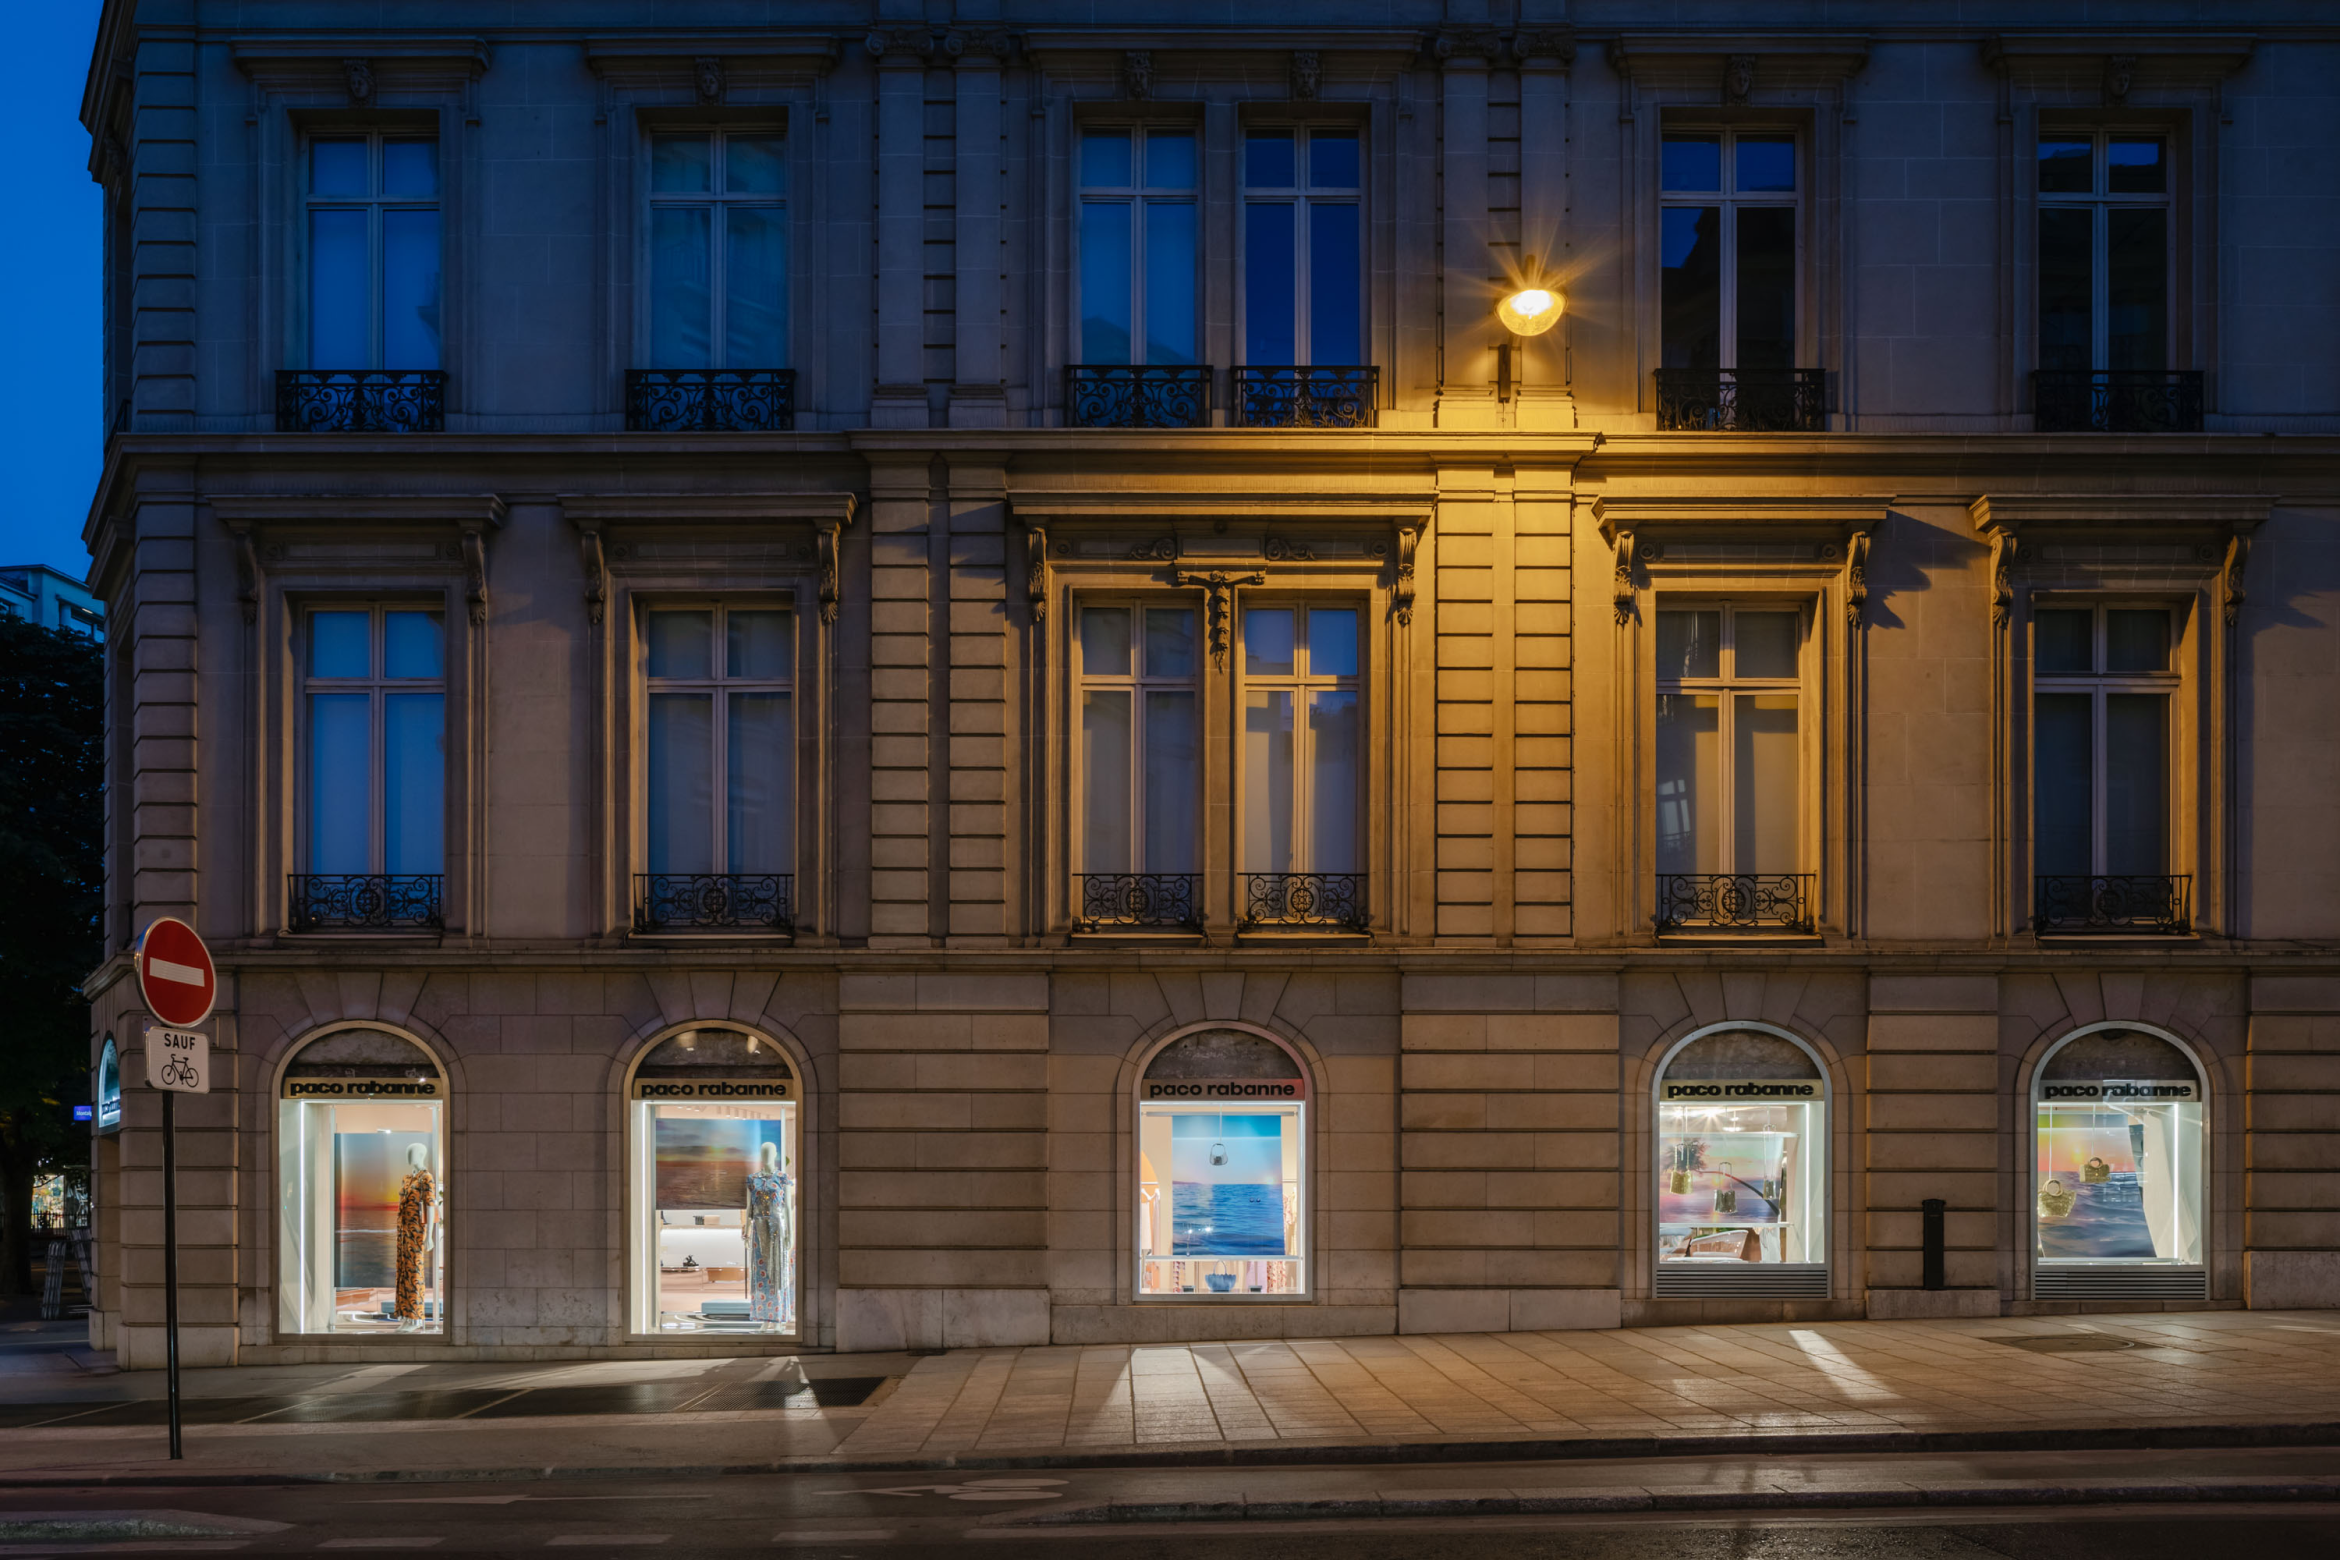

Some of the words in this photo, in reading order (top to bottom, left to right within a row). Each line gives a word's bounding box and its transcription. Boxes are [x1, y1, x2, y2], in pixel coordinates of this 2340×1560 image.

[164, 1033, 196, 1050] SAUF
[290, 1083, 344, 1097] paco
[347, 1081, 436, 1094] rabanne
[641, 1085, 695, 1098] paco
[698, 1082, 786, 1096] rabanne
[1150, 1085, 1202, 1098] paco
[1207, 1082, 1295, 1096] rabanne
[1667, 1085, 1721, 1098] paco
[1725, 1082, 1814, 1096] rabanne
[2045, 1085, 2098, 1099] paco
[2102, 1083, 2191, 1097] rabanne
